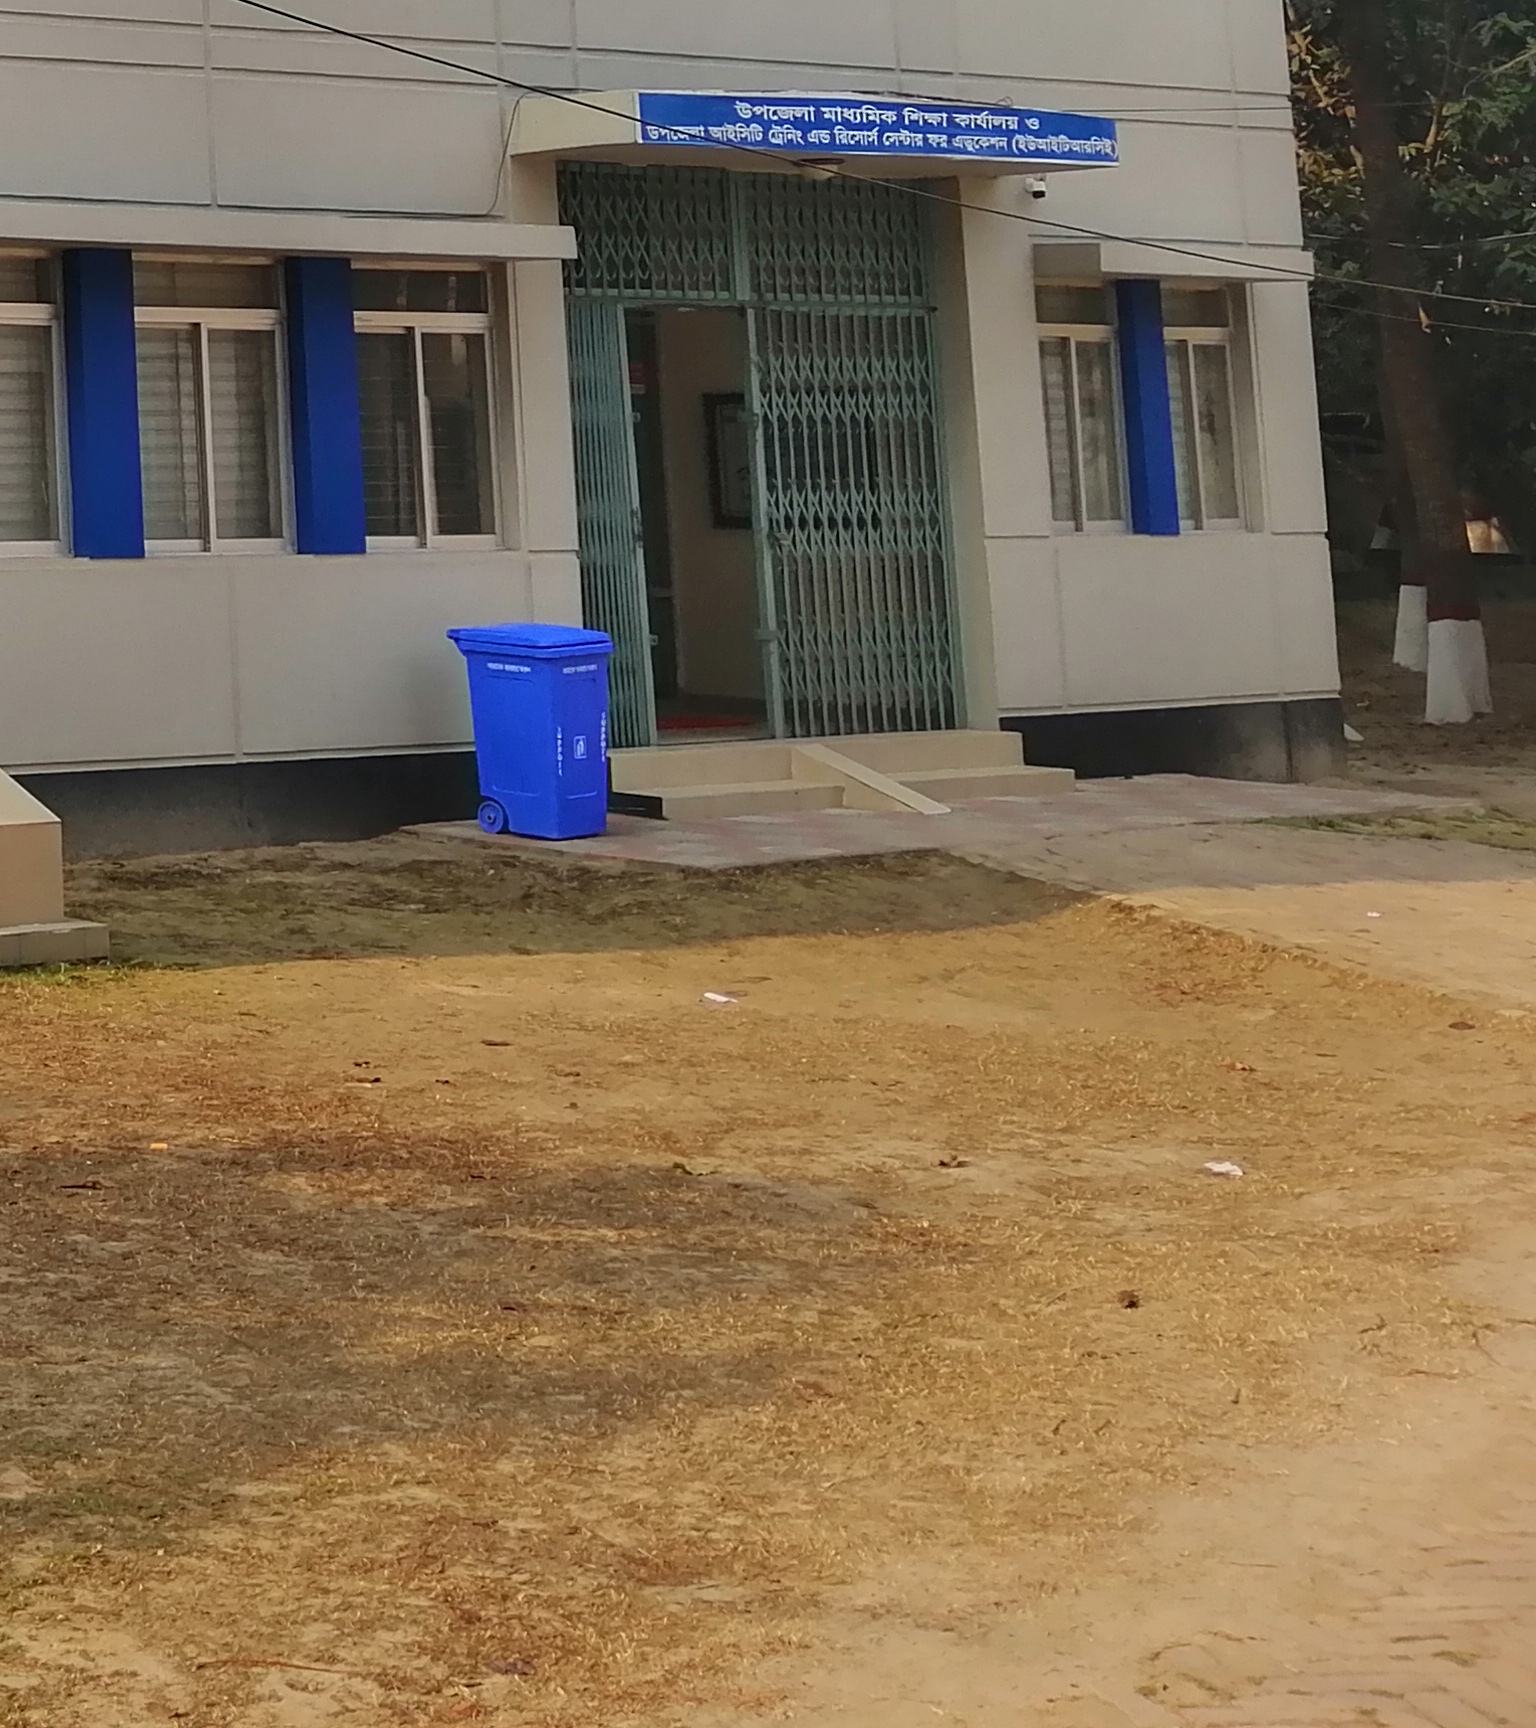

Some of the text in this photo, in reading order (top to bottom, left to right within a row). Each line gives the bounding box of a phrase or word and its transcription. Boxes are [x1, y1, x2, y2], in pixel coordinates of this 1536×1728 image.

[734, 100, 1040, 131] উপজেলা মাধ্যমিক শিক্ষা কার্যালয় ও
[707, 122, 764, 143] আইসিটি
[768, 123, 805, 146] ট্রেনিং
[833, 125, 880, 146] রিসোর্স
[883, 129, 924, 149] সেন্টার
[926, 132, 949, 149] ফর
